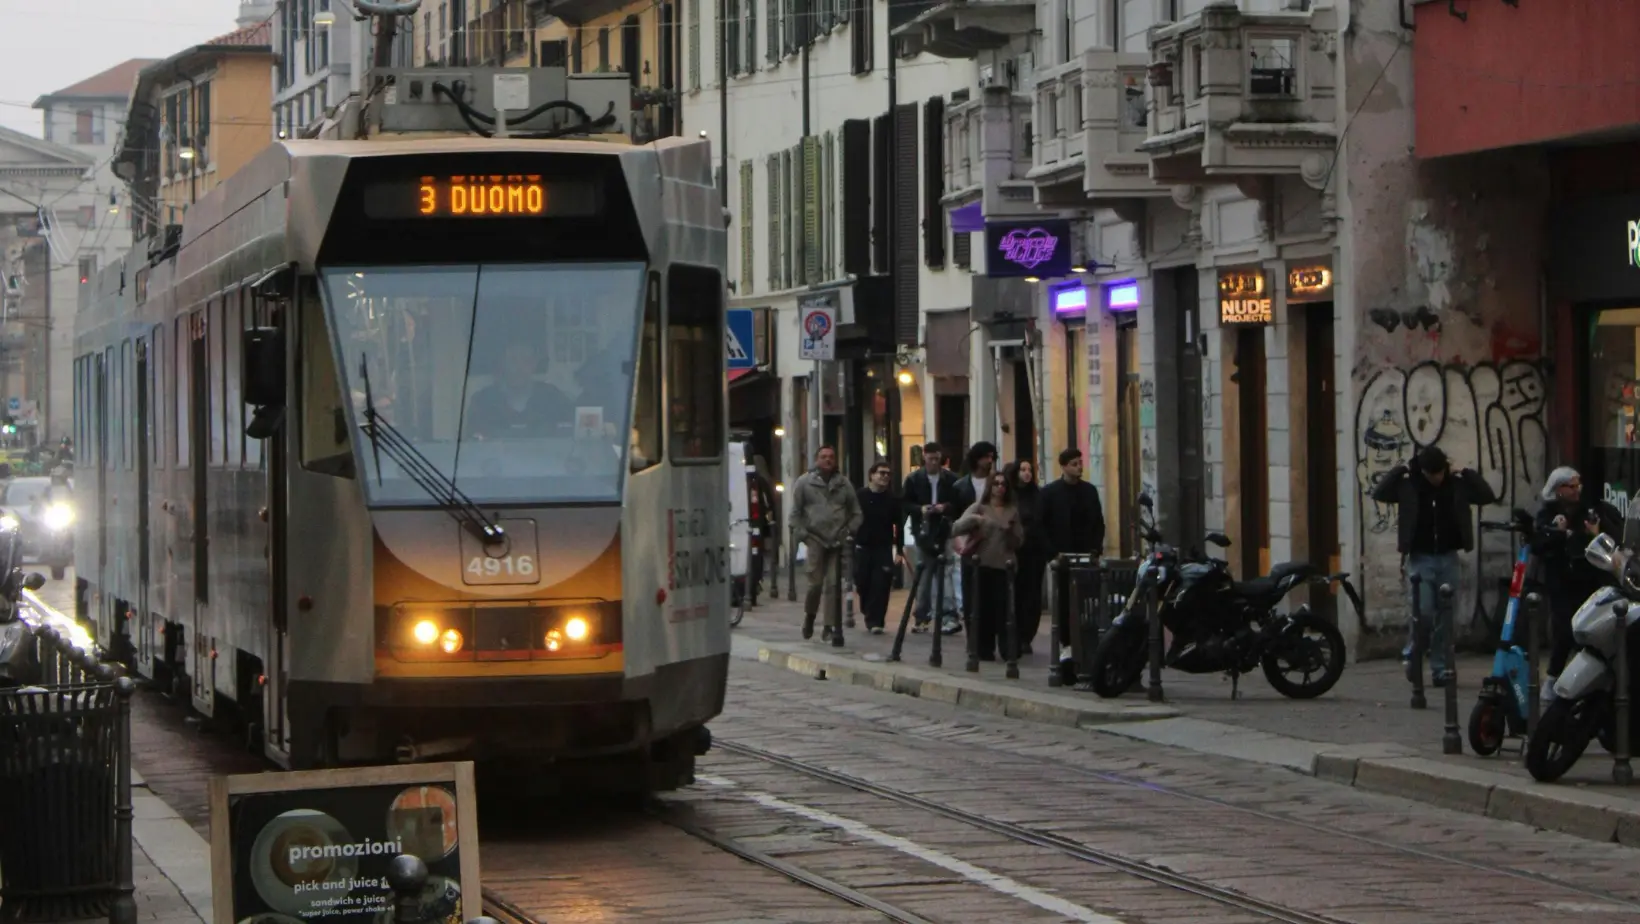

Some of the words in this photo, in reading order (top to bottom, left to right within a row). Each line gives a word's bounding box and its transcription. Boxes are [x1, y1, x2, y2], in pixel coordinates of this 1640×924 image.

[420, 185, 435, 213] 3
[451, 184, 542, 213] DUOMO
[1221, 299, 1271, 315] NUDE
[467, 555, 534, 576] 4916
[288, 835, 403, 864] promozioni
[294, 880, 319, 895] pick
[322, 879, 346, 891] and
[348, 877, 378, 890] juice
[311, 896, 354, 907] sandwich
[363, 895, 386, 905] juice
[342, 907, 364, 915] power
[365, 904, 385, 913] shake
